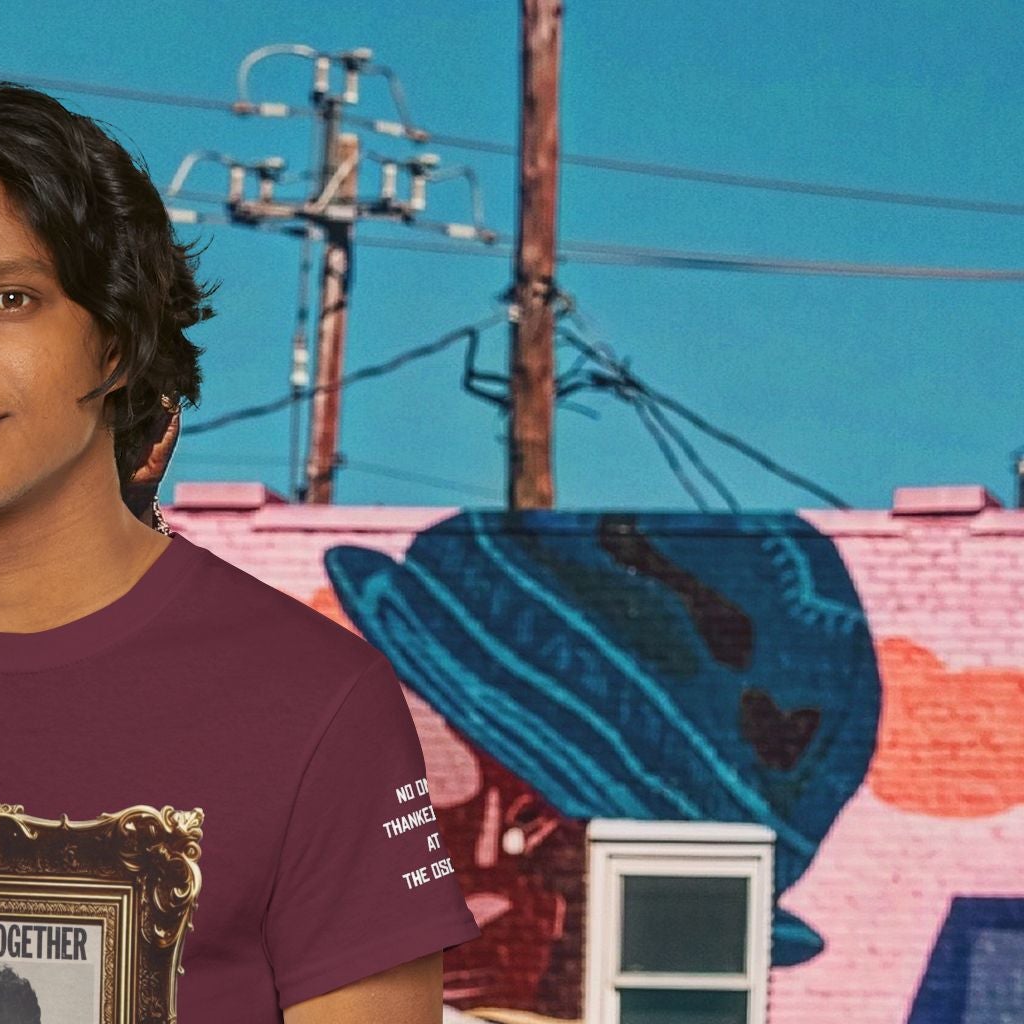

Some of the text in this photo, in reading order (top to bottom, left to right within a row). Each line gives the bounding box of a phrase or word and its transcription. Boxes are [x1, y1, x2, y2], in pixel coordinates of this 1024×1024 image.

[396, 783, 415, 803] NO
[427, 832, 440, 852] AT
[402, 866, 430, 889] THE
